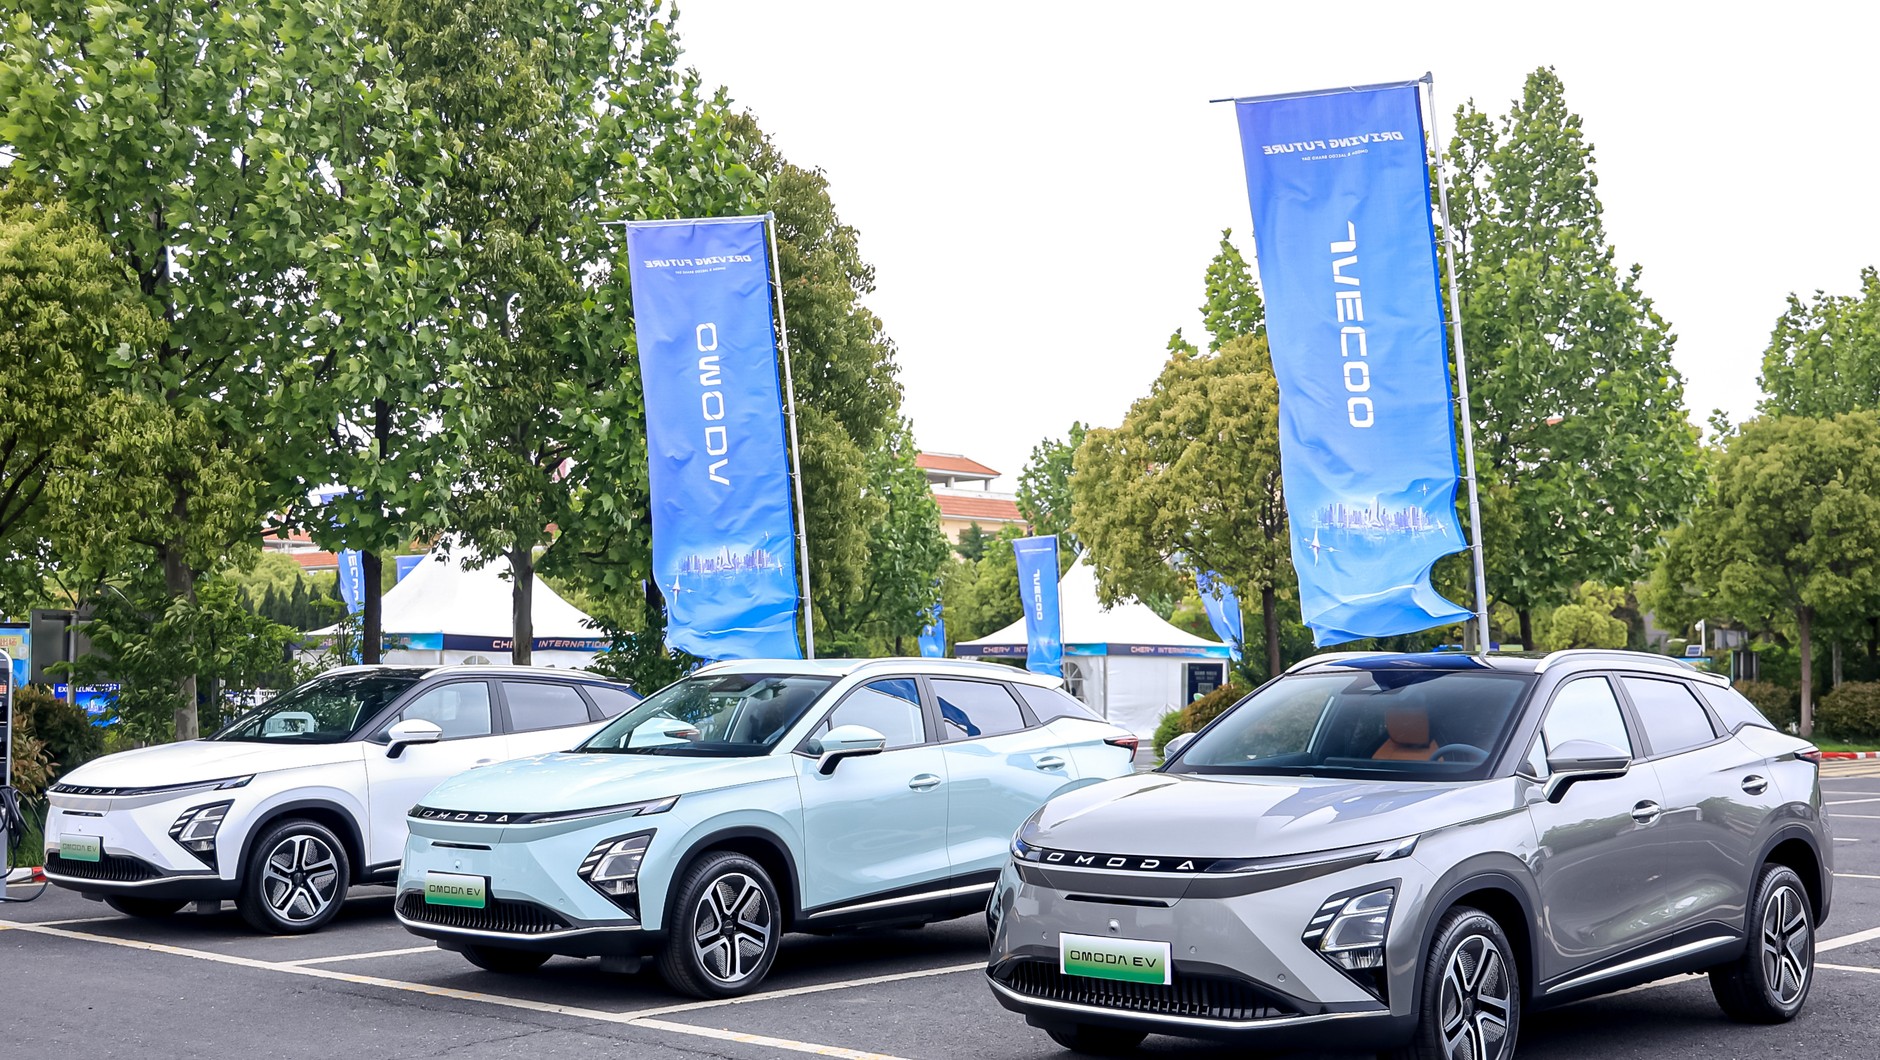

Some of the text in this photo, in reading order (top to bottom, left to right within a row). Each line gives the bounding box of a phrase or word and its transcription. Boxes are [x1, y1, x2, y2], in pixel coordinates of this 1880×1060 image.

[983, 646, 1010, 654] CHERY
[422, 810, 509, 822] OMODA
[1047, 852, 1195, 870] OMODA
[429, 884, 480, 896] OMODA EV
[1070, 950, 1157, 968] OMODA EV
